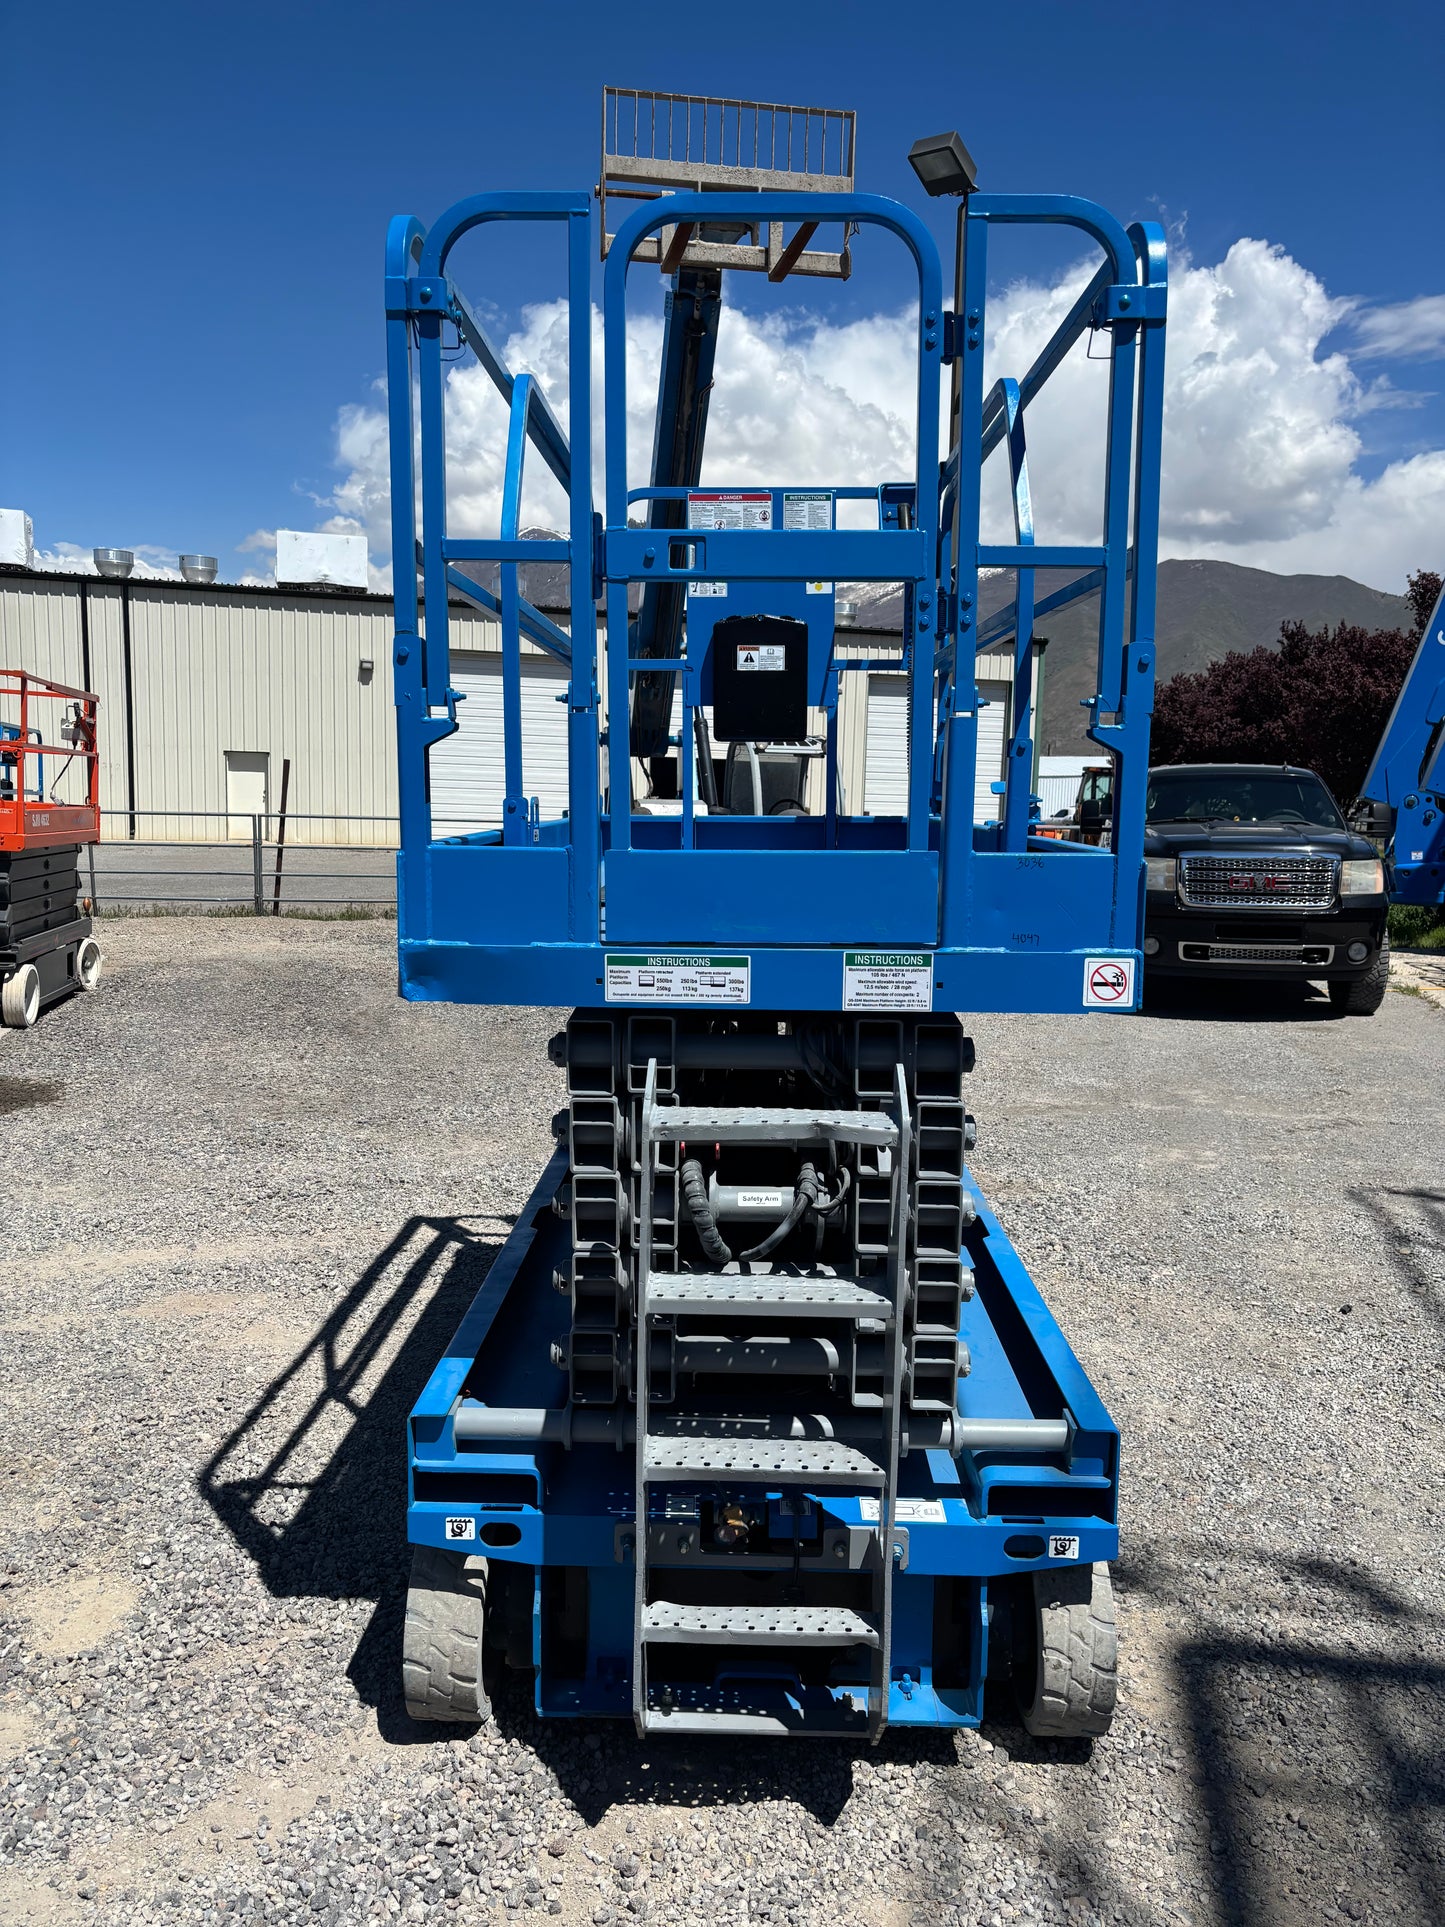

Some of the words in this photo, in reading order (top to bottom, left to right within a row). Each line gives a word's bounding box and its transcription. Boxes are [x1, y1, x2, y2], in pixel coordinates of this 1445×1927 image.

[1016, 857, 1045, 870] 3036
[1011, 933, 1040, 947] 4047
[647, 957, 711, 967] INSTRUCTIONS
[854, 955, 924, 965] INSTRUCTIONS
